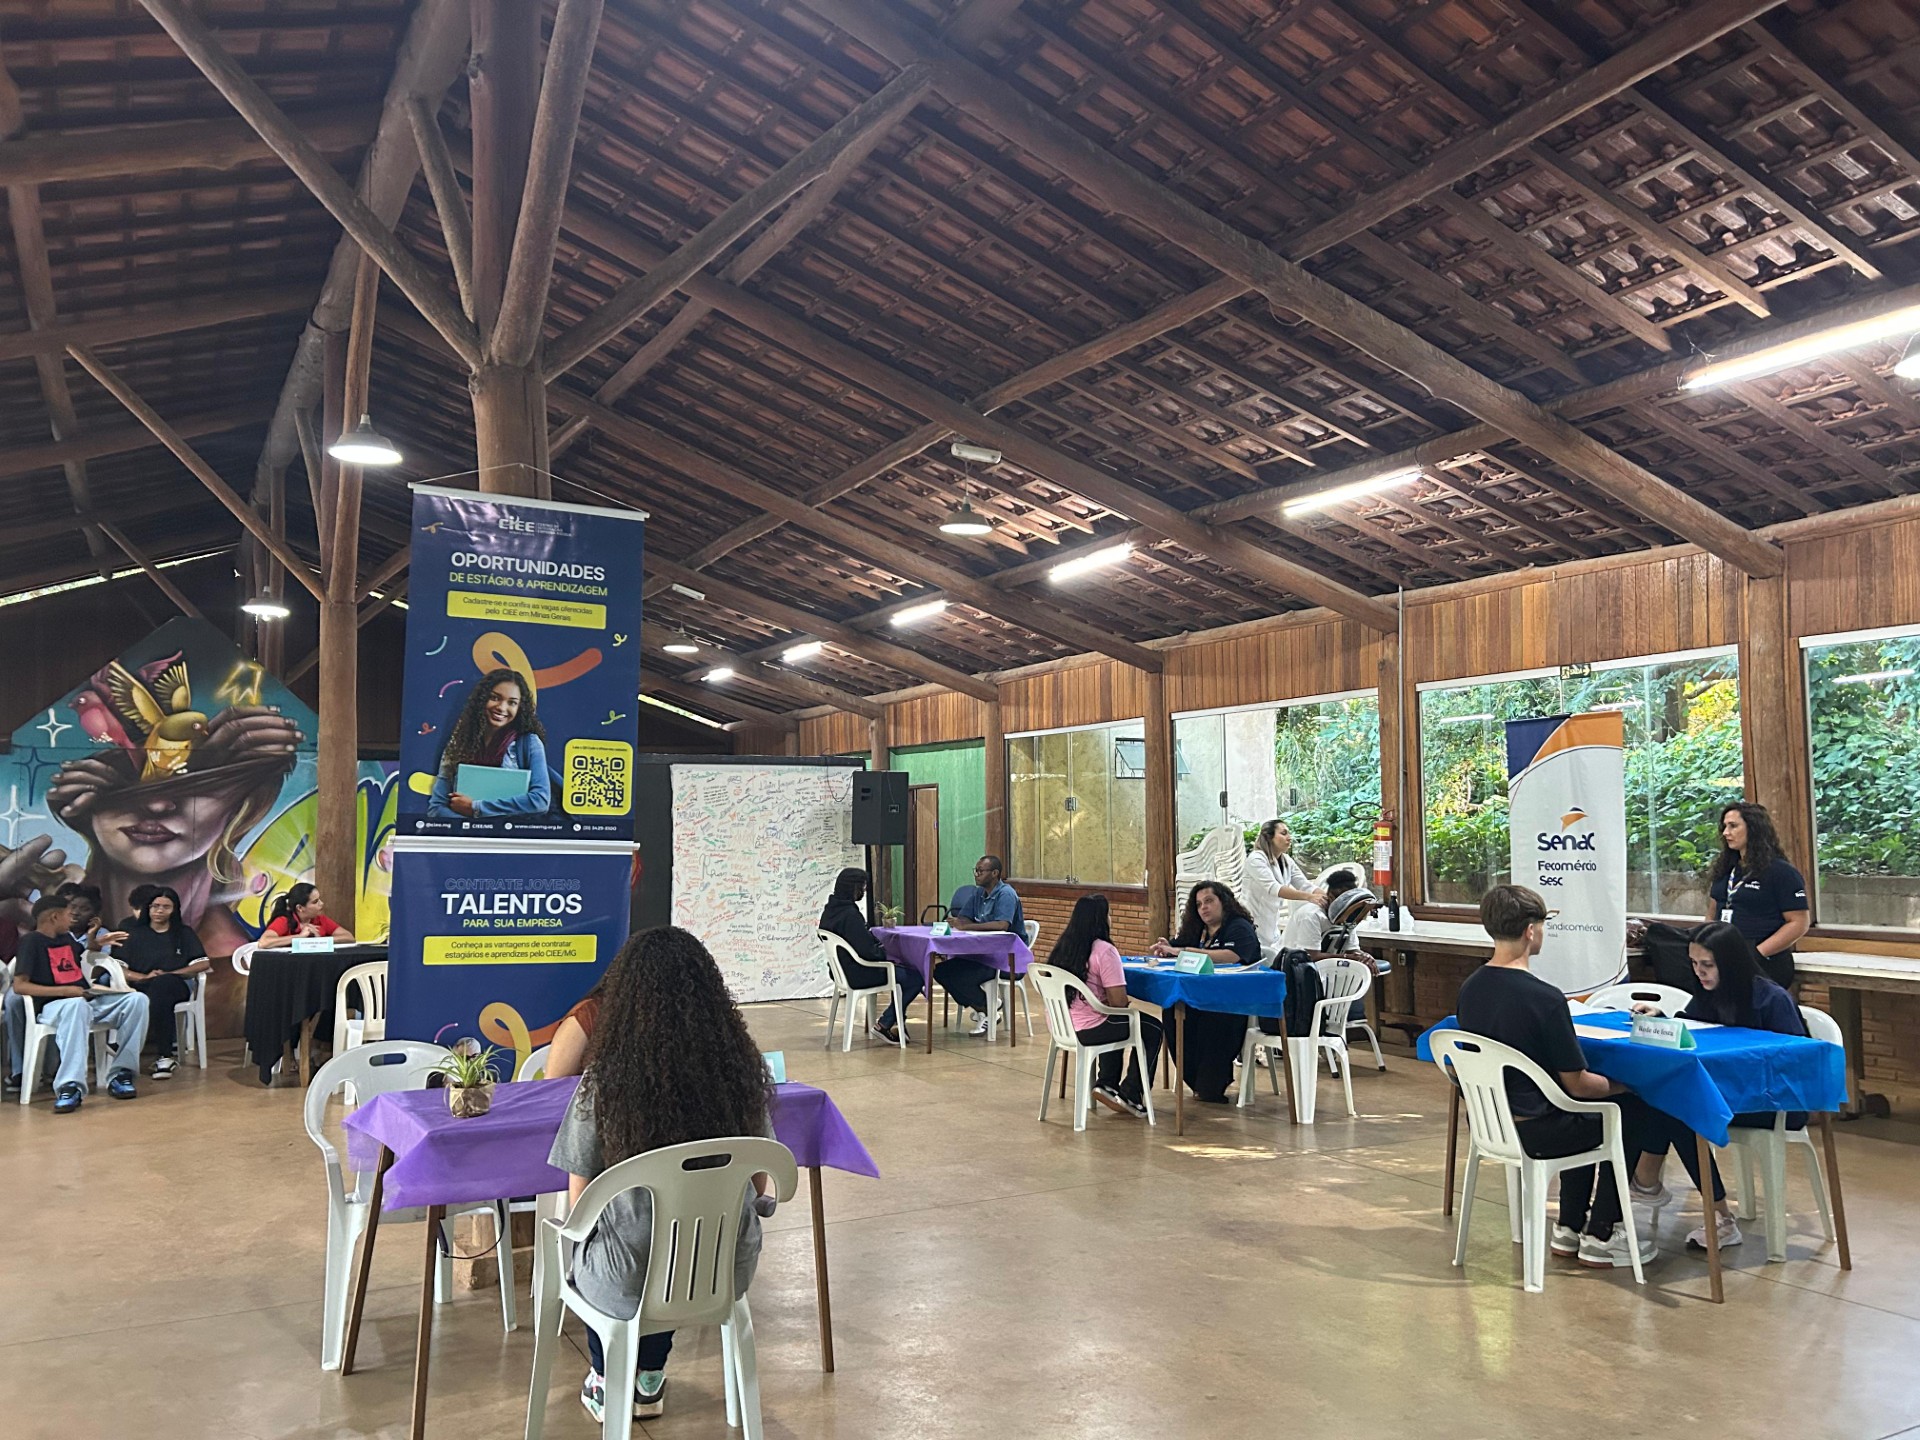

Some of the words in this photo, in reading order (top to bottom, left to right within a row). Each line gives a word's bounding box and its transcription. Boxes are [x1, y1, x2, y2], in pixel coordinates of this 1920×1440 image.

[451, 552, 605, 581] OPORTUNIDADES
[449, 572, 464, 583] DE
[467, 573, 514, 587] ESTÁGIO
[516, 578, 524, 588] &
[526, 580, 608, 596] APRENDIZAGEM
[463, 597, 502, 606] Cadastre-se
[541, 604, 559, 612] vagas
[560, 606, 593, 615] oferecidas
[502, 608, 518, 616] CIEE
[531, 611, 550, 619] Minas
[551, 613, 571, 621] Gerais
[1537, 832, 1596, 851] Senac
[1538, 859, 1597, 871] Fecomércio
[444, 878, 523, 891] CONTRATE
[524, 878, 581, 891] JOVENS
[1539, 875, 1564, 886] Sesc
[441, 893, 583, 915] TALENTOS
[463, 919, 490, 928] PARA
[494, 919, 515, 928] SUA
[516, 918, 563, 928] EMPRESA
[451, 941, 483, 949] Conheça
[494, 941, 530, 949] vantagens
[445, 950, 484, 960] estagiários
[490, 950, 529, 959] aprendizes
[529, 950, 545, 958] pelo
[545, 949, 577, 957] CIEE/MG
